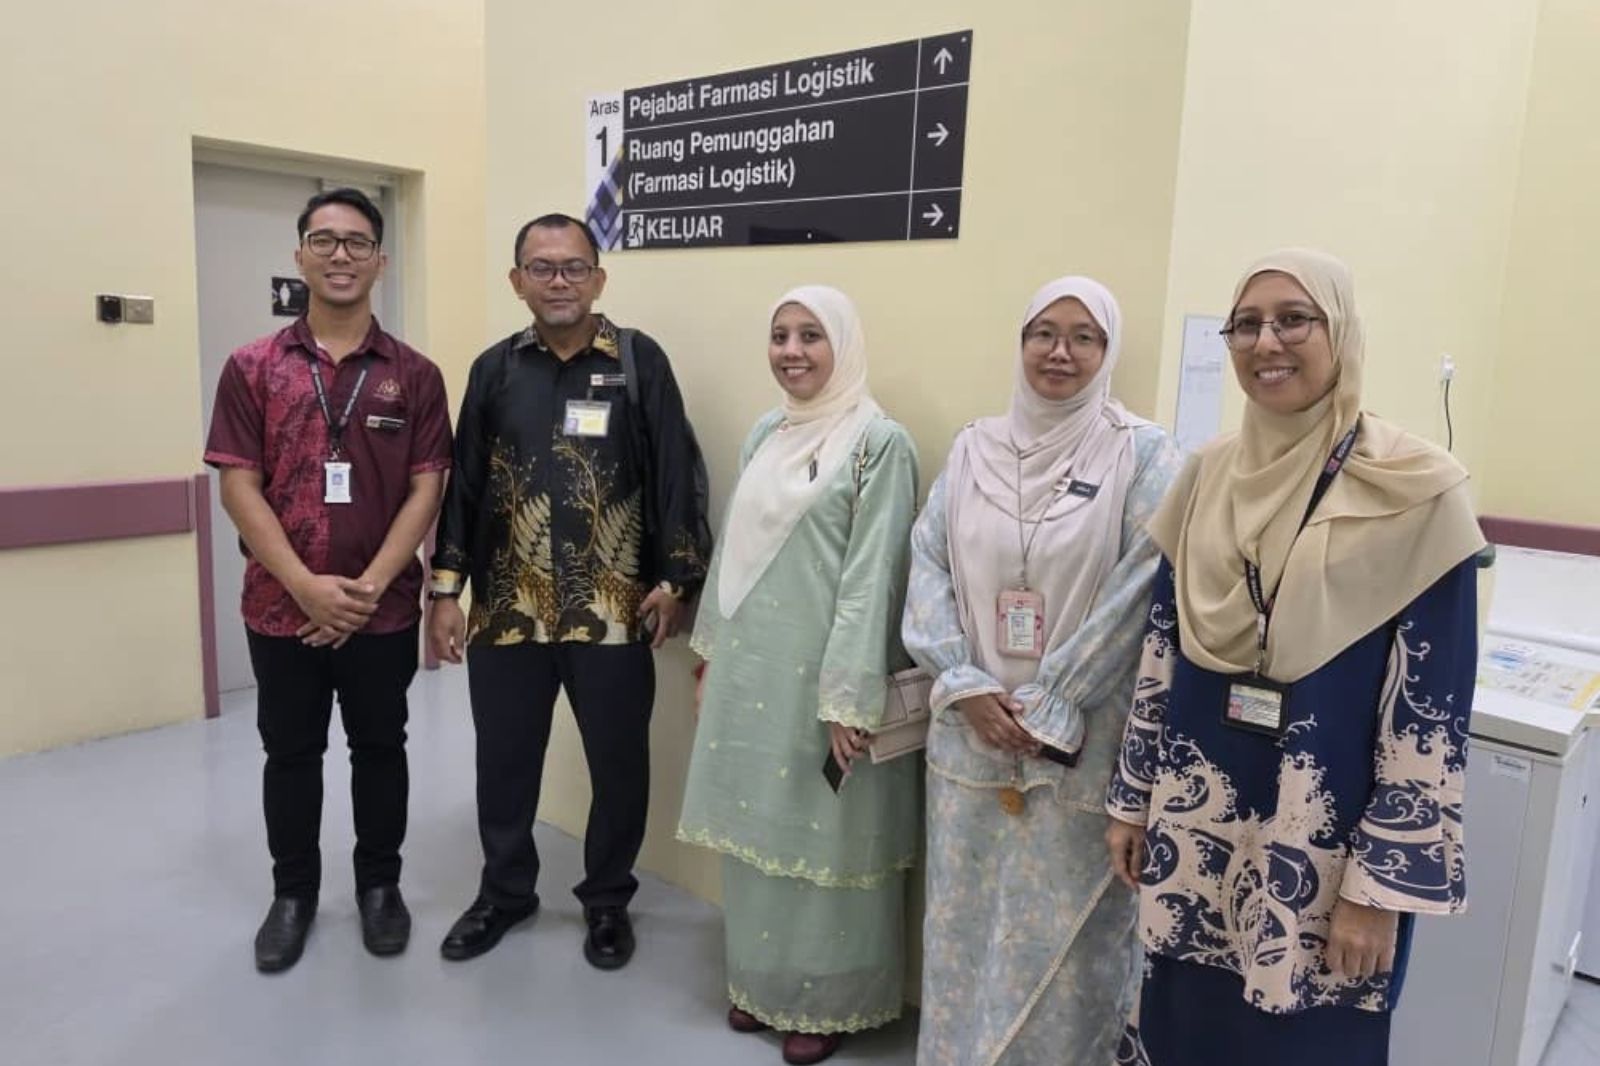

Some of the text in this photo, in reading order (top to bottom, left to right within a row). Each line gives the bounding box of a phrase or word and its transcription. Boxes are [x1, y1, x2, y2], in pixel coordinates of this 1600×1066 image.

[589, 99, 620, 117] Aras
[629, 57, 875, 121] Pejabat Farmasi Logistik
[595, 126, 608, 168] 1
[629, 118, 835, 163] Ruang Pemunggahan
[628, 157, 796, 199] (Farmasi Logistik)
[646, 215, 723, 240] KELUAR
